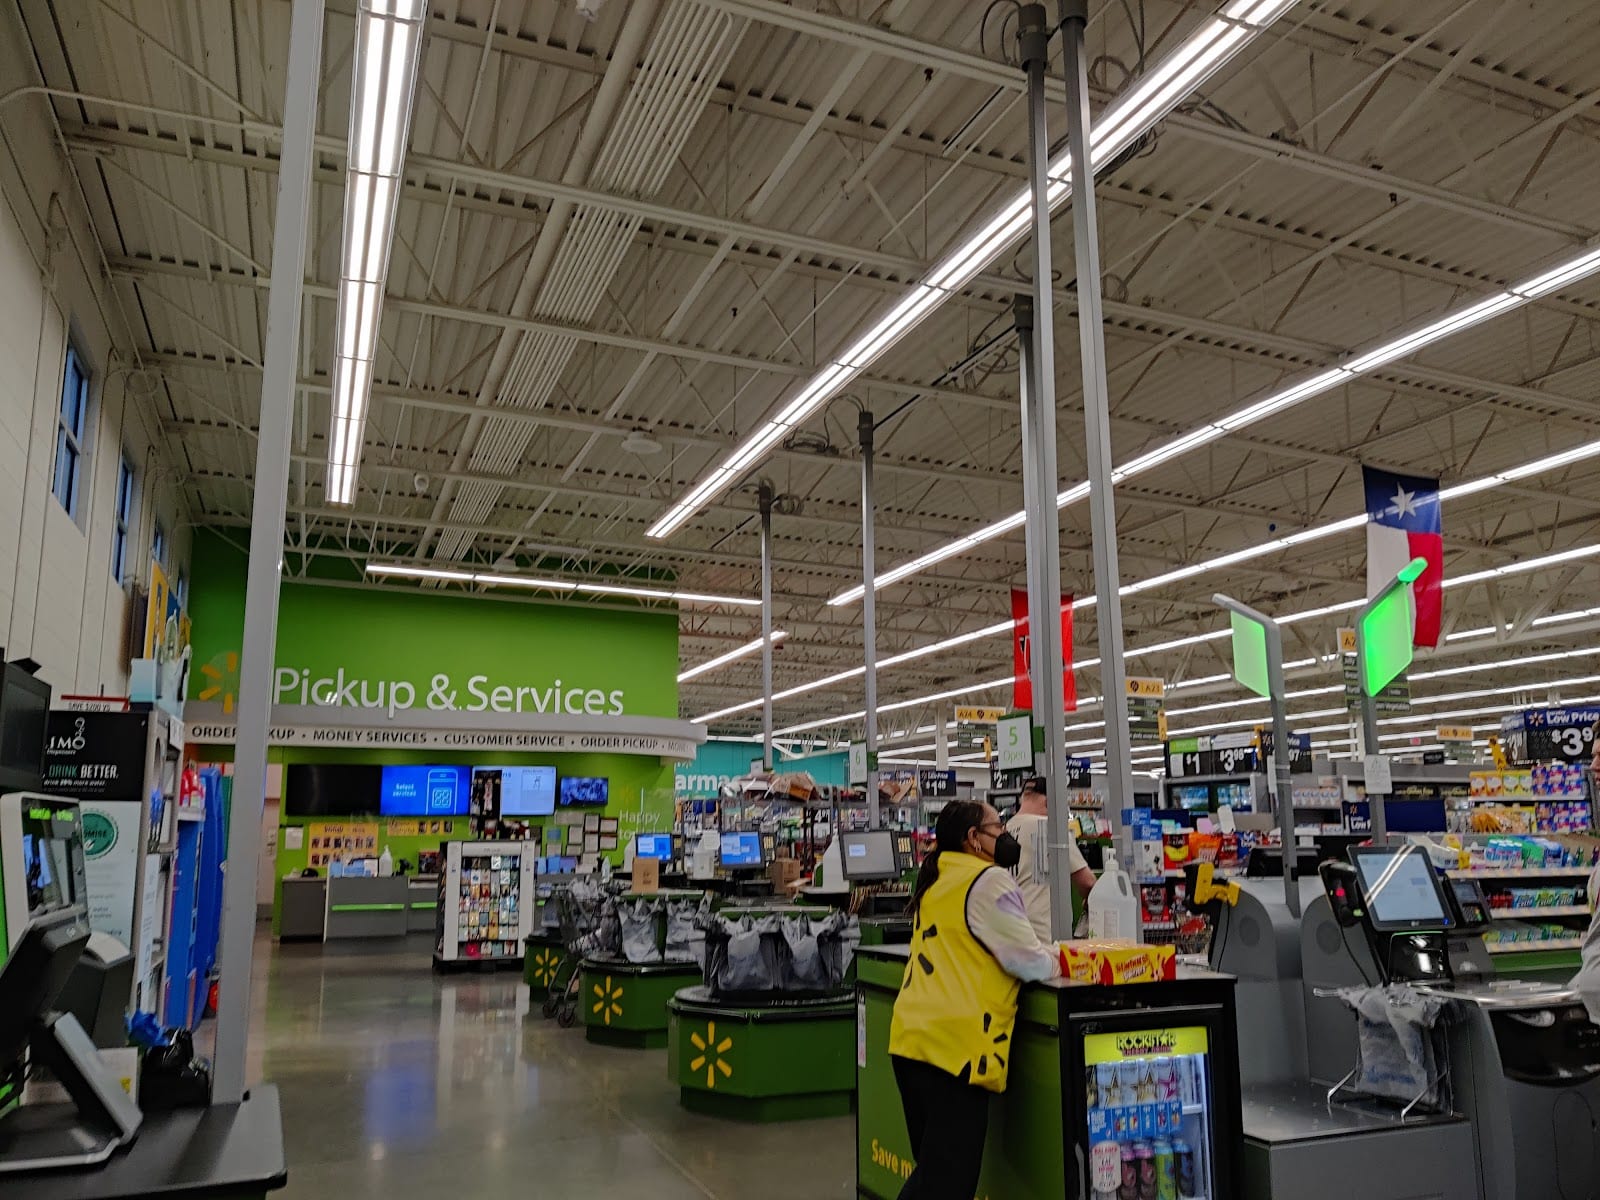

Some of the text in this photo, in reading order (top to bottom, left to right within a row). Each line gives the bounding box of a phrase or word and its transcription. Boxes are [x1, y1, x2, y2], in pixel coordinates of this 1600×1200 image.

[273, 667, 624, 719] Pickup & Services
[1546, 711, 1600, 725] Low Price
[268, 728, 295, 740] KUP
[313, 729, 363, 743] MONEY
[366, 730, 427, 745] SERVICES
[444, 733, 514, 746] CUSTOMER
[516, 734, 565, 747] SERVICE
[580, 736, 620, 748] ORDER
[622, 737, 658, 750] PICKUP
[1008, 725, 1018, 746] 5
[1552, 726, 1594, 756] $39
[1003, 750, 1026, 765] Open
[1186, 752, 1200, 775] $1
[48, 764, 78, 778] DRINK
[872, 1138, 898, 1175] Save
